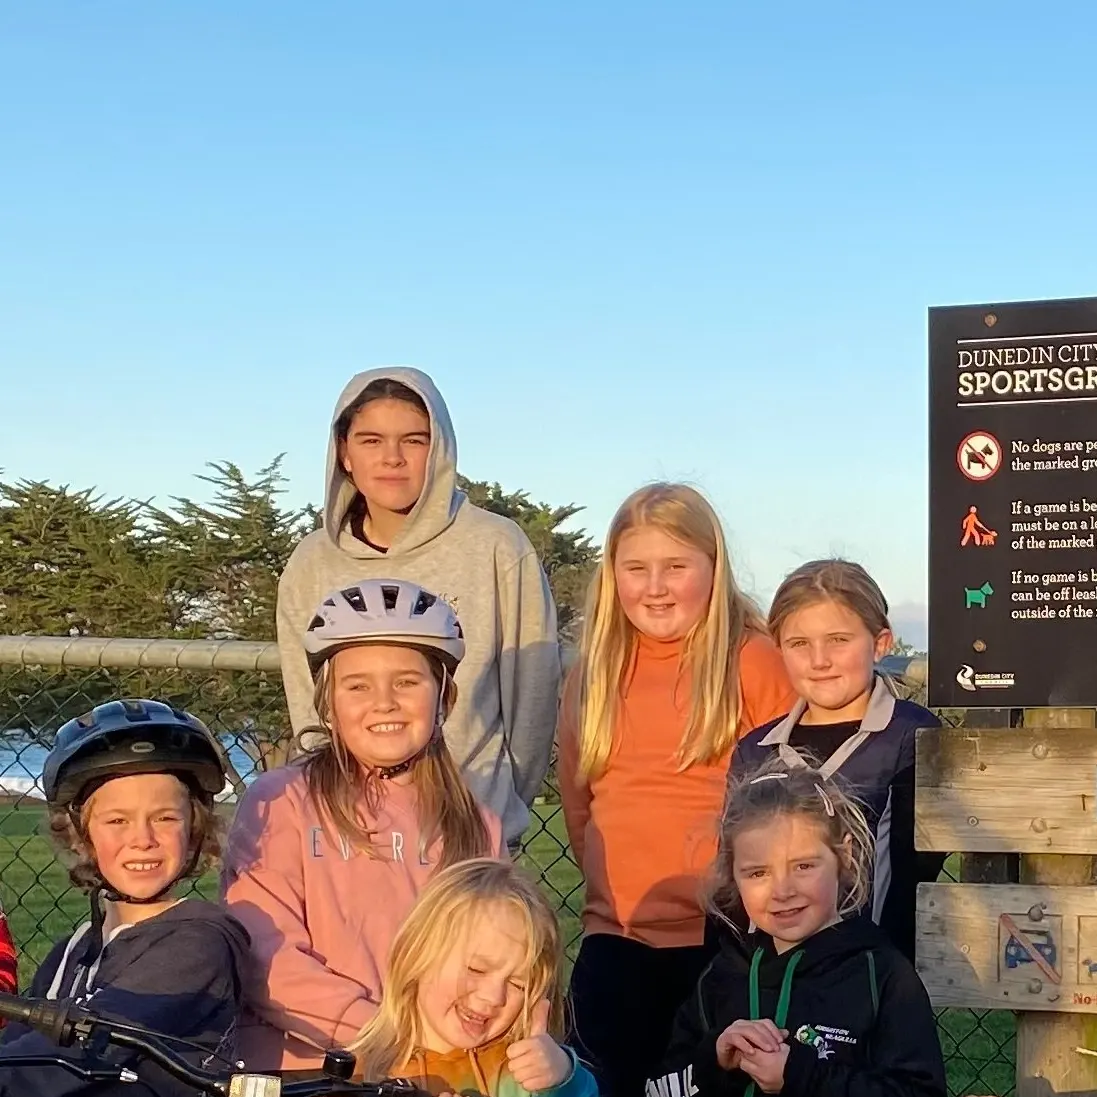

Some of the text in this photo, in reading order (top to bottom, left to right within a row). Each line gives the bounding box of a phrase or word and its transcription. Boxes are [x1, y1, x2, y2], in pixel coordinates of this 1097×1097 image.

[957, 345, 1054, 368] DUNEDIN
[1011, 440, 1030, 454] No
[1031, 438, 1062, 455] dogs
[1063, 441, 1084, 451] are
[1011, 457, 1031, 471] the
[1033, 455, 1080, 471] marked
[1011, 500, 1022, 515] If
[1023, 504, 1032, 515] a
[1033, 503, 1067, 517] game
[1069, 500, 1080, 513] is
[1011, 520, 1042, 533] must
[1043, 517, 1060, 531] be
[1061, 521, 1078, 531] on
[1079, 520, 1088, 530] a
[1011, 535, 1025, 550] of
[1026, 535, 1046, 549] the
[1048, 533, 1095, 549] marked
[1011, 569, 1023, 585] If
[1023, 574, 1040, 584] no
[1041, 573, 1076, 586] game
[1077, 570, 1089, 583] is
[1011, 592, 1034, 602] can
[1035, 587, 1051, 601] be
[1052, 586, 1071, 601] off
[1011, 605, 1057, 619] outside
[1058, 604, 1072, 618] of
[1072, 604, 1094, 618] the
[1073, 993, 1092, 1005] No
